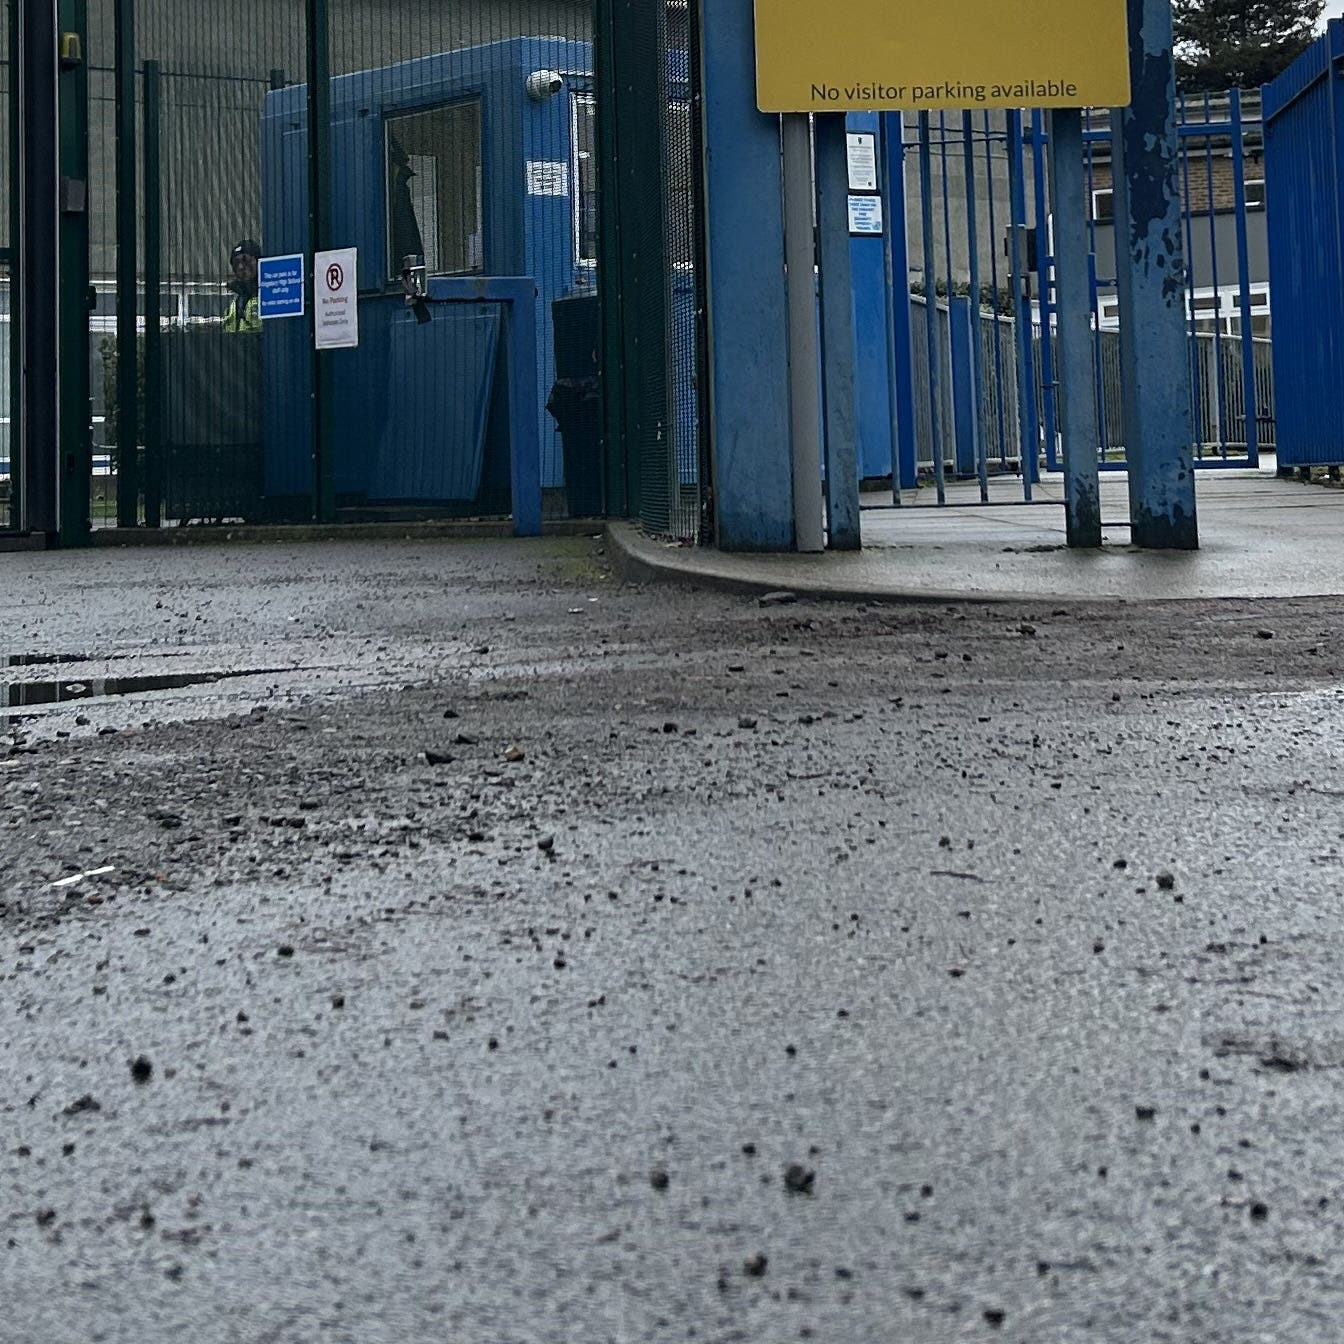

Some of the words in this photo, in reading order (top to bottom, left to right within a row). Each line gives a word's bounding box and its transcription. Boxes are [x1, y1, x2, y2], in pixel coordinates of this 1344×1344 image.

[810, 83, 840, 101] No
[844, 82, 906, 100] visitor
[912, 80, 986, 103] parking
[990, 79, 1077, 98] available
